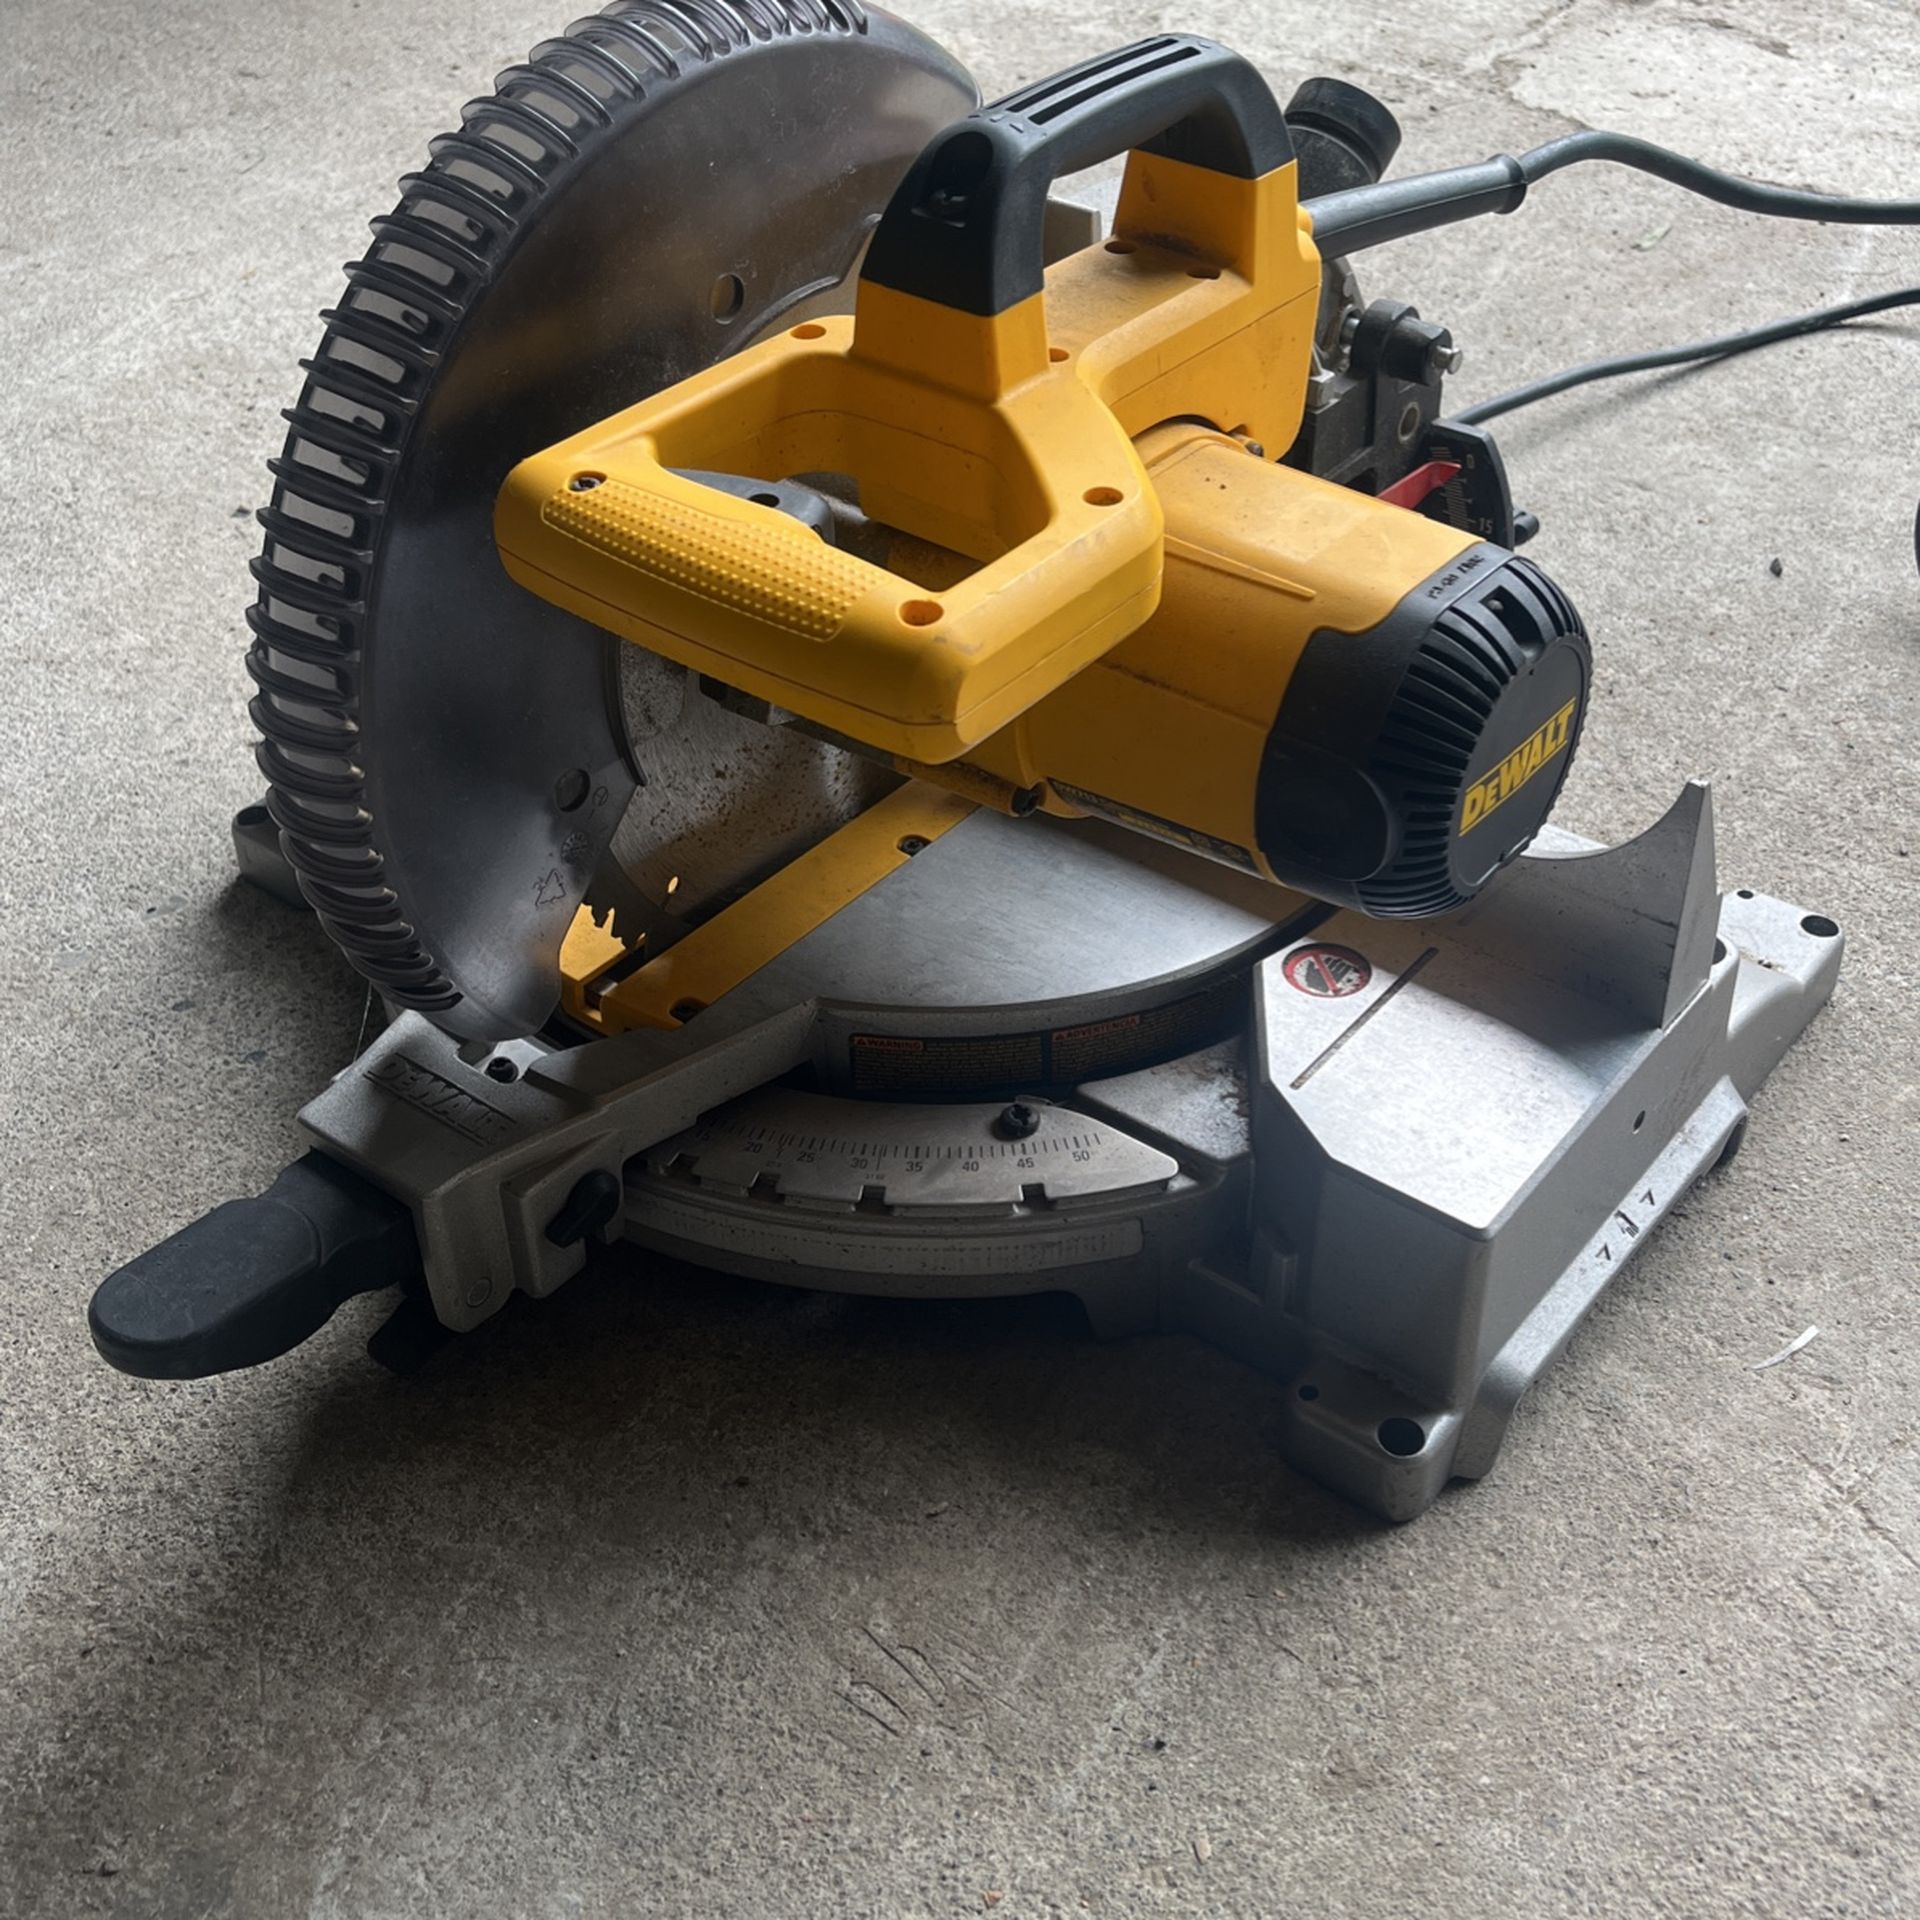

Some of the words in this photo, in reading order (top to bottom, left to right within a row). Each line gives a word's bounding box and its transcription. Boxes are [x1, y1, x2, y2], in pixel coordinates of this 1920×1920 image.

[1479, 516, 1493, 534] 15
[1460, 701, 1576, 832] DEWALT
[868, 1038, 921, 1050] WARNING
[743, 1141, 762, 1154] 20
[796, 1151, 815, 1164] 25
[850, 1157, 868, 1170] 30
[905, 1160, 923, 1173] 35
[962, 1160, 979, 1173] 40
[1017, 1157, 1034, 1170] 45
[1072, 1150, 1090, 1163] 50
